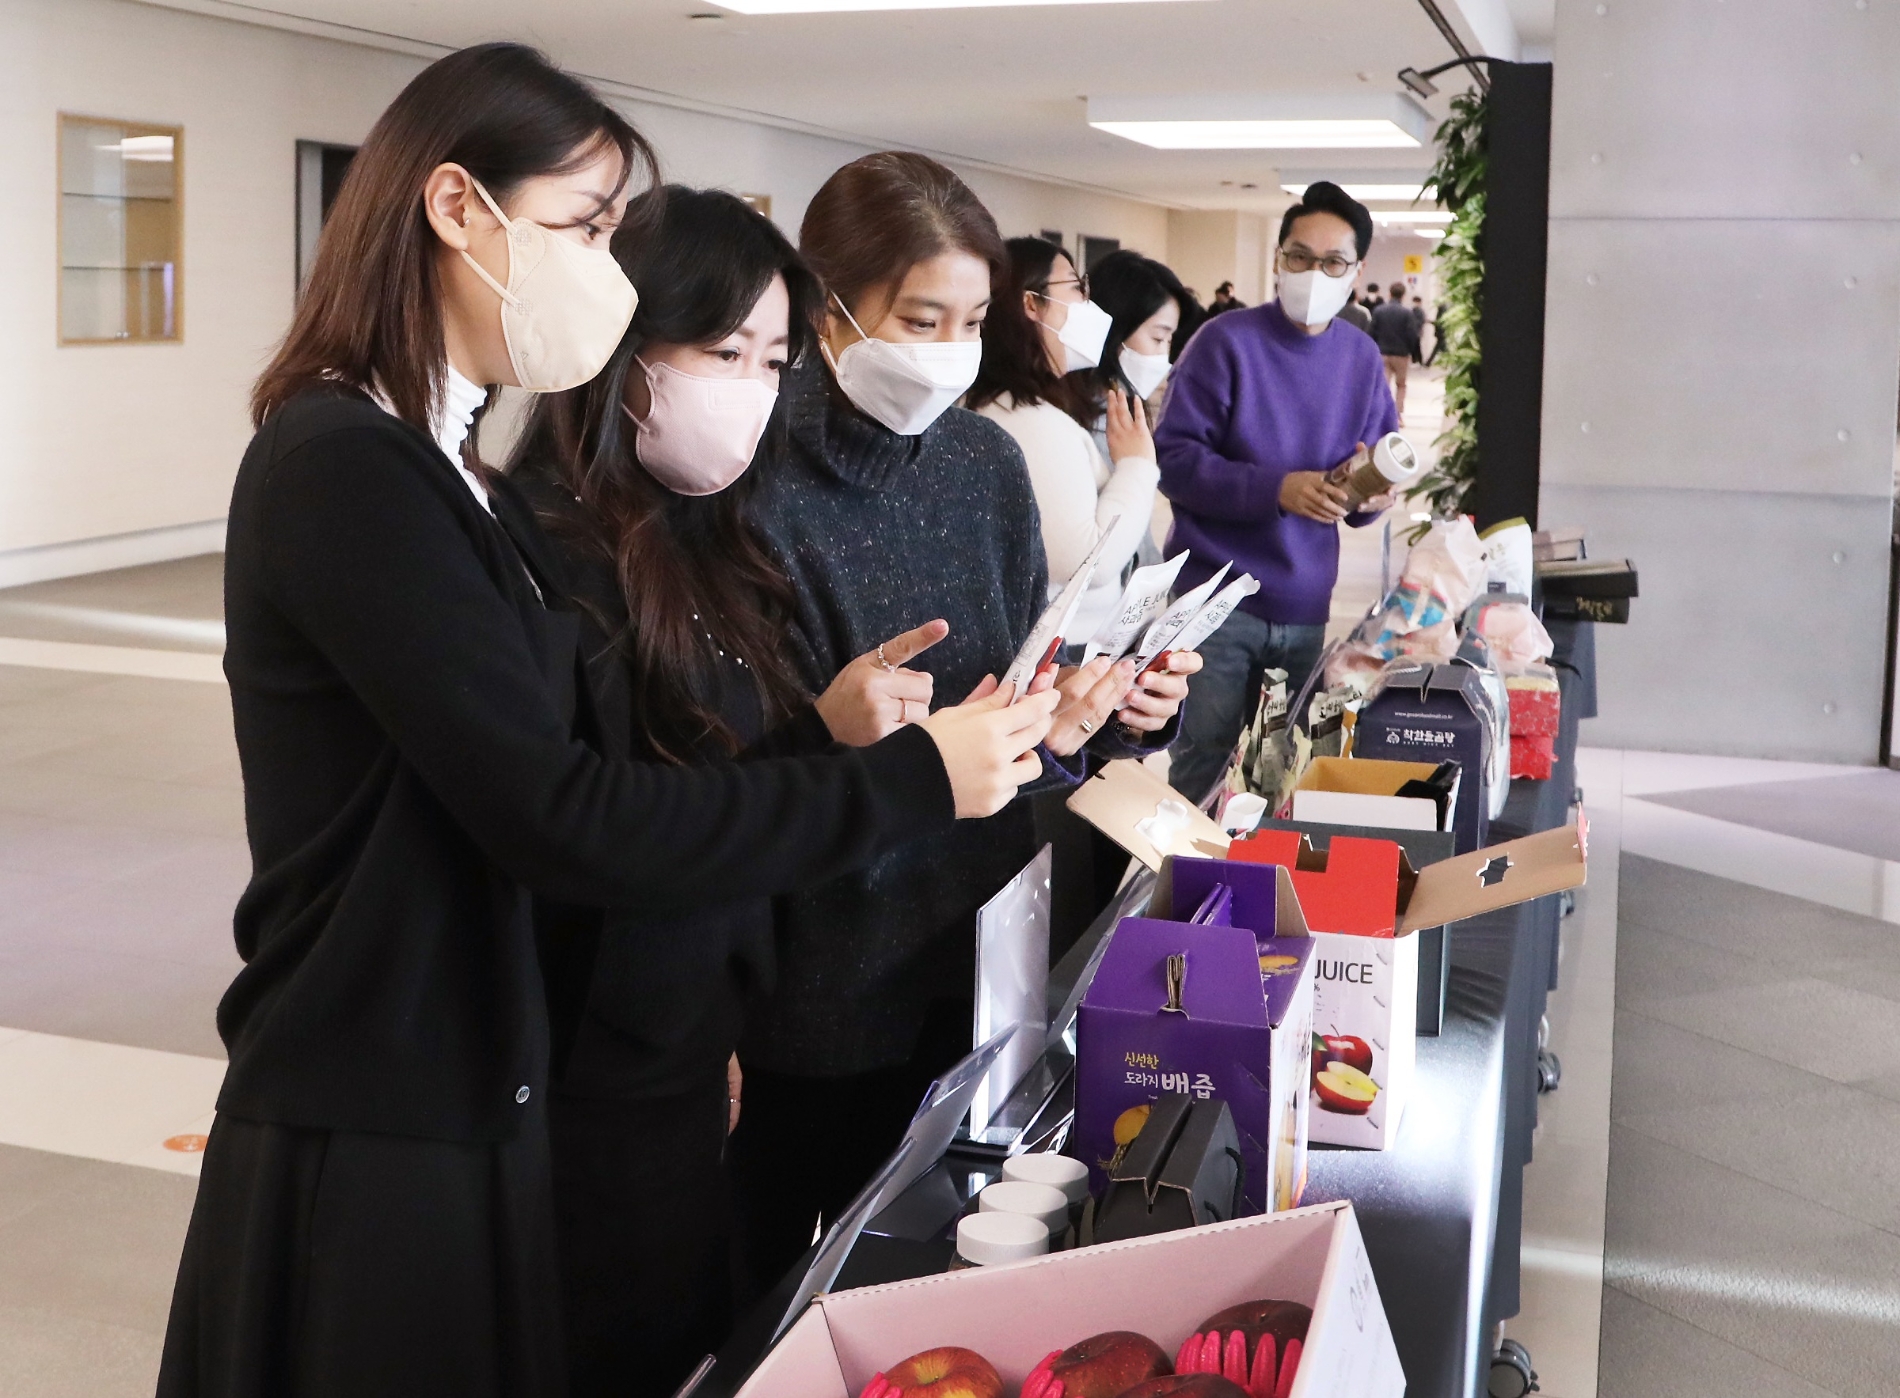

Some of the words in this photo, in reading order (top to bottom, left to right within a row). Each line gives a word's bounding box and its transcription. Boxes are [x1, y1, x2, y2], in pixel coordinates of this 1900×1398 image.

[1314, 959, 1373, 984] JUICE
[1124, 1051, 1160, 1070] 신선한
[1123, 1071, 1159, 1089] 도라지
[1161, 1072, 1216, 1100] 배즙
